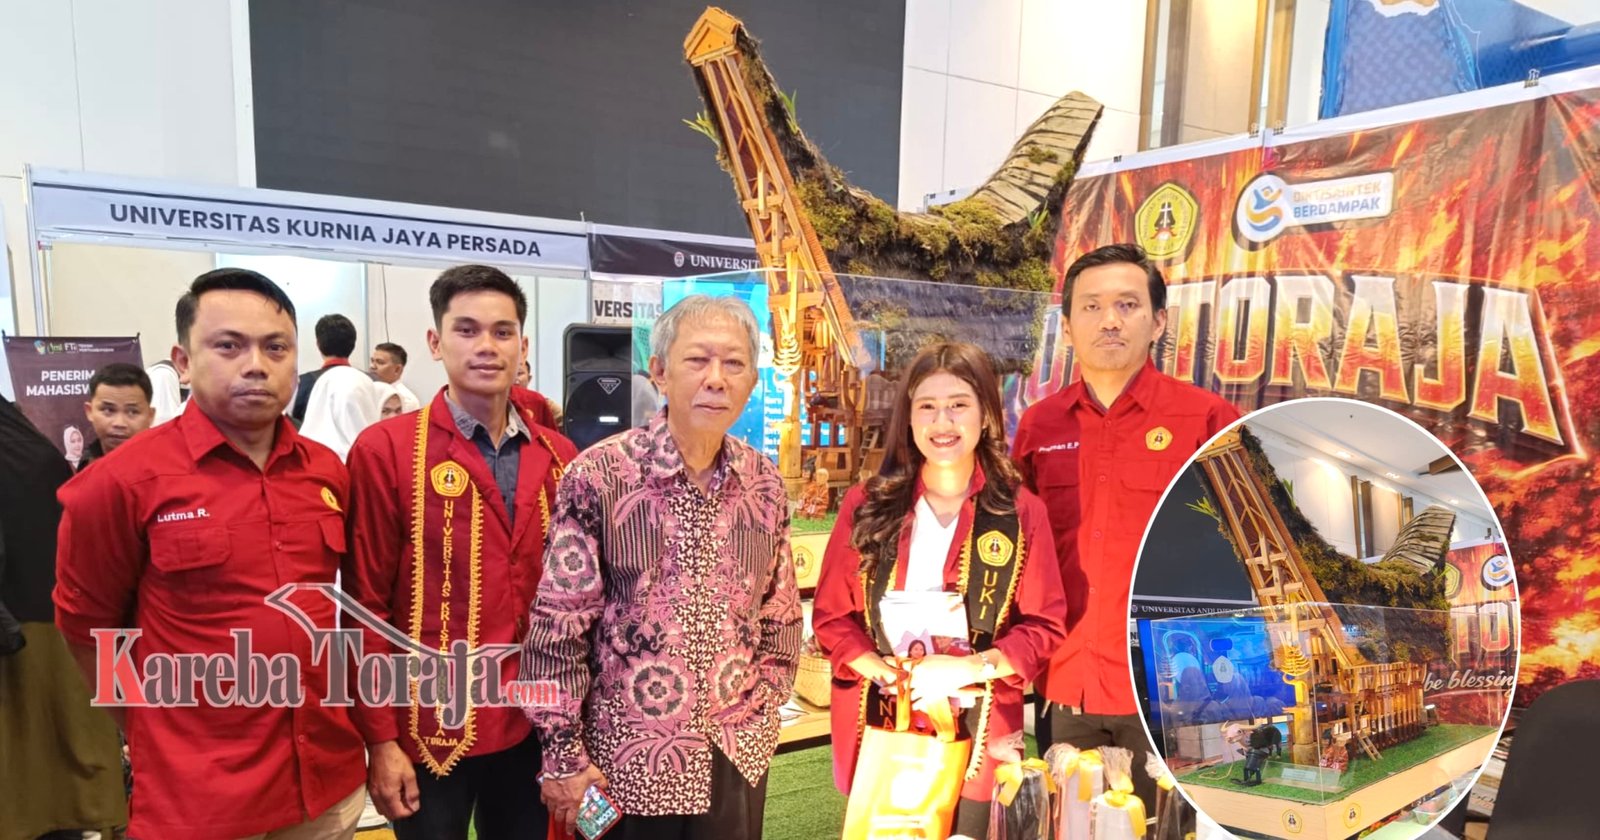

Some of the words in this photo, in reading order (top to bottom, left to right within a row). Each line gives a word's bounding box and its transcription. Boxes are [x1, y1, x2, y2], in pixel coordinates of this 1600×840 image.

[1293, 197, 1380, 218] BERDAMPAK
[110, 203, 281, 235] UNIVERSITAS
[286, 218, 377, 243] KURNIA
[381, 227, 442, 249] JAYA
[447, 233, 541, 257] PERSADA
[1164, 275, 1564, 446] TORAJA
[197, 507, 211, 518] R.
[442, 500, 454, 597] UNIVERSITAS
[979, 569, 999, 620] UKI
[1141, 605, 1195, 615] UNIVERSITAS
[1424, 672, 1444, 692] be
[423, 735, 460, 747] TORAJA
